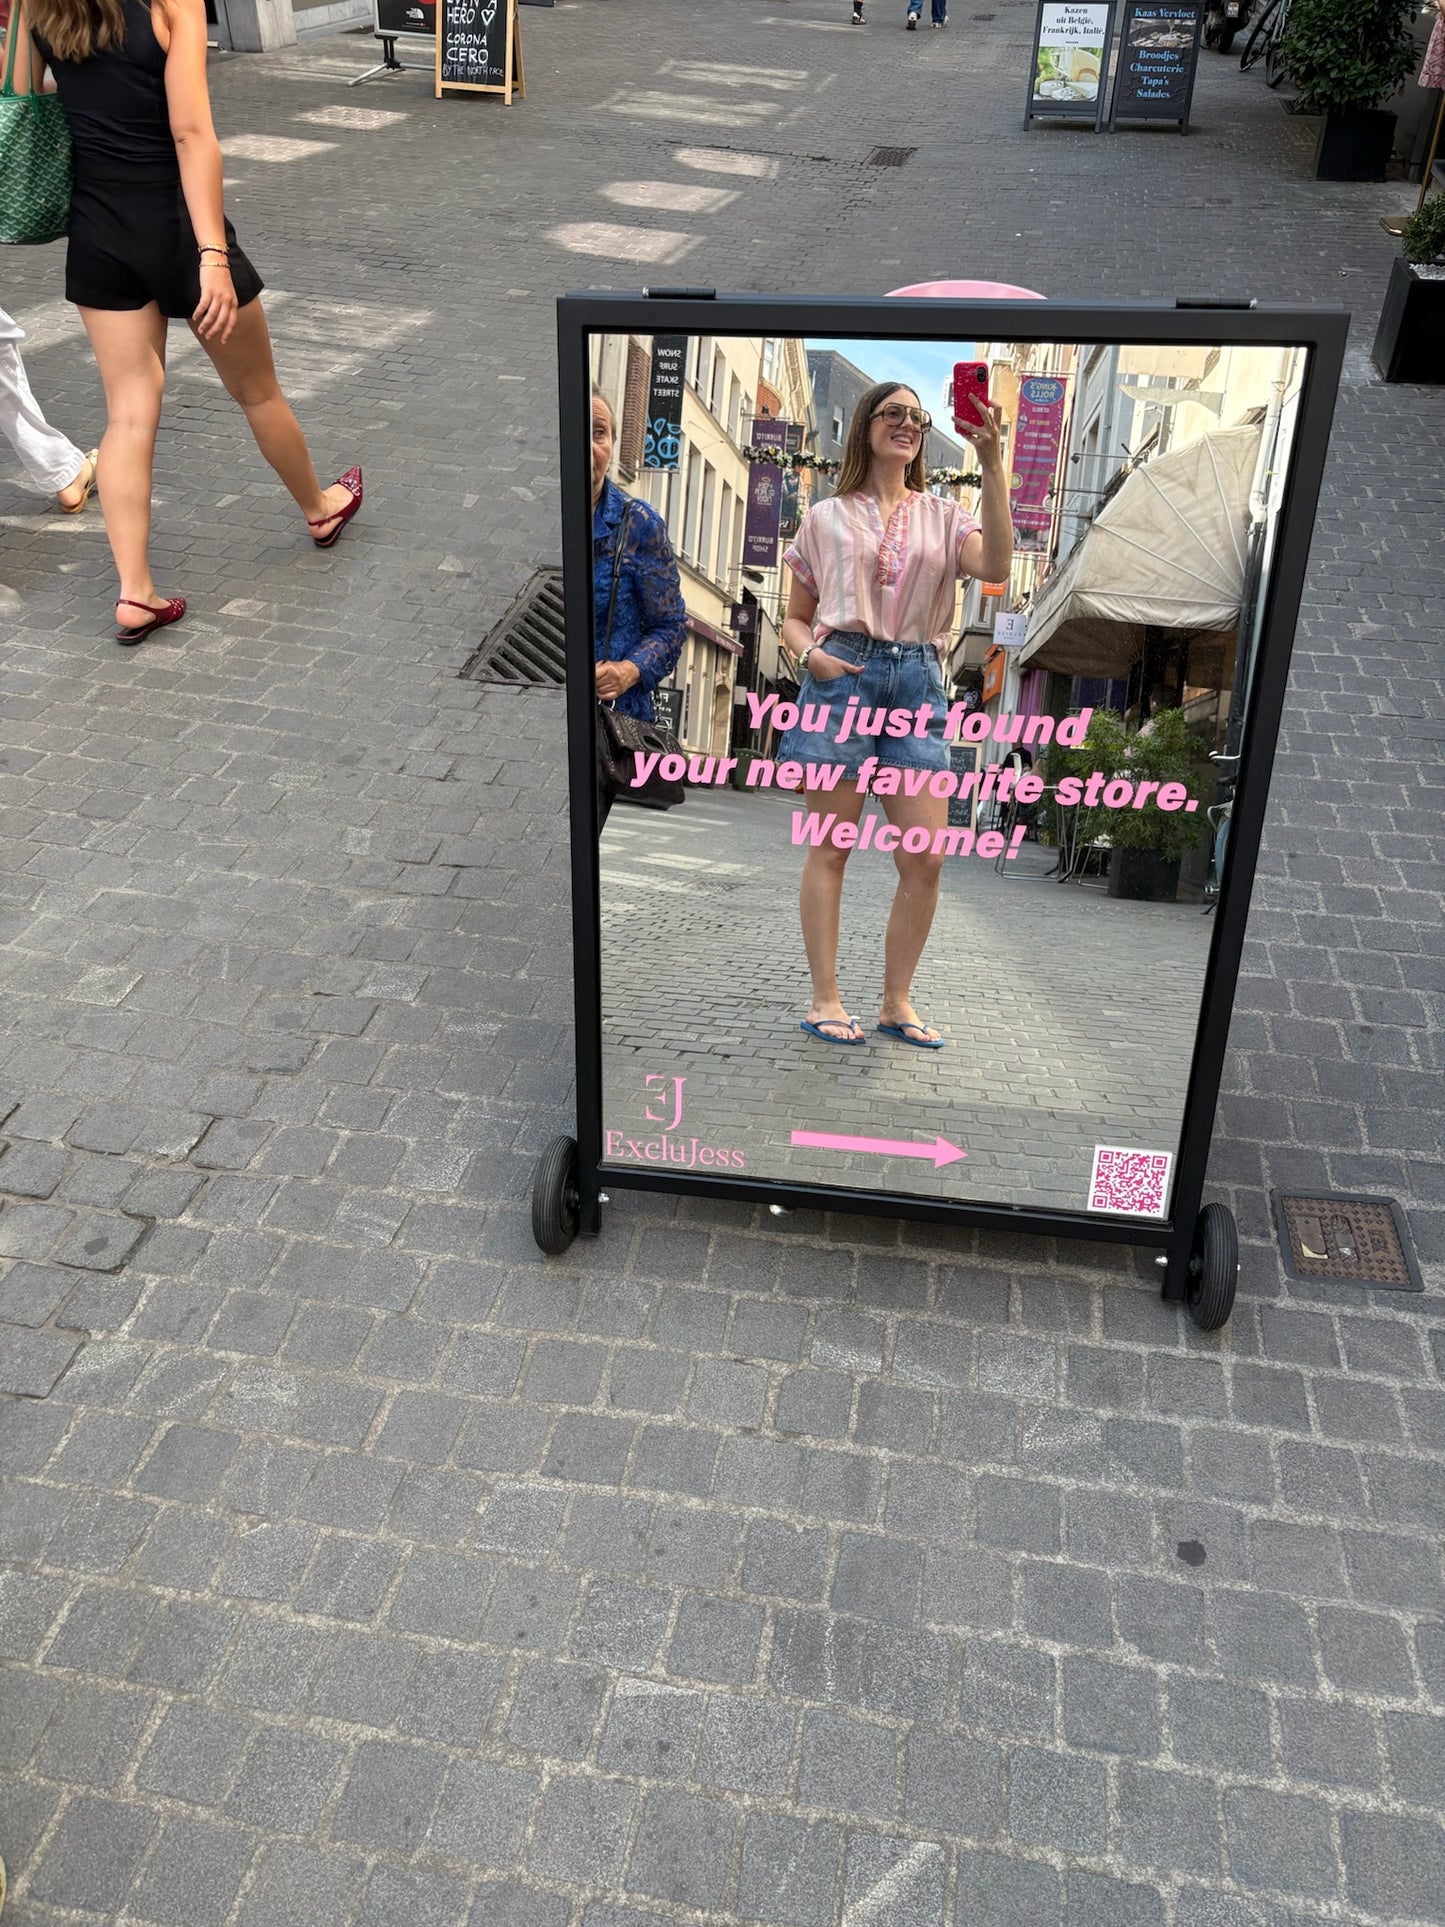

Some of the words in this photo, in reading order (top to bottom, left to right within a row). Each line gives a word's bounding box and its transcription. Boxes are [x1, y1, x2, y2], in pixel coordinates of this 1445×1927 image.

[447, 7, 475, 24] HERO
[1064, 6, 1088, 14] Kazen
[1134, 8, 1157, 17] Kaas
[1159, 8, 1196, 18] Vervloet
[1056, 16, 1067, 24] uit
[446, 32, 487, 46] CORONA
[446, 47, 489, 64] CERO
[1139, 50, 1179, 62] Broodjes
[443, 64, 452, 77] BY
[453, 64, 464, 76] THE
[467, 65, 488, 76] NORTH
[489, 67, 504, 77] FACE
[1130, 63, 1184, 73] Charcuterie
[1141, 75, 1169, 87] Tapa's
[1136, 88, 1170, 99] Salades
[745, 692, 830, 732] You
[834, 696, 934, 743] just
[943, 701, 1094, 747] found
[630, 751, 738, 788] your
[745, 759, 845, 791] new
[855, 756, 1045, 804] favorite
[1055, 772, 1199, 812] store.
[790, 811, 1027, 859] Welcome!
[605, 1130, 746, 1169] ExcluJess
